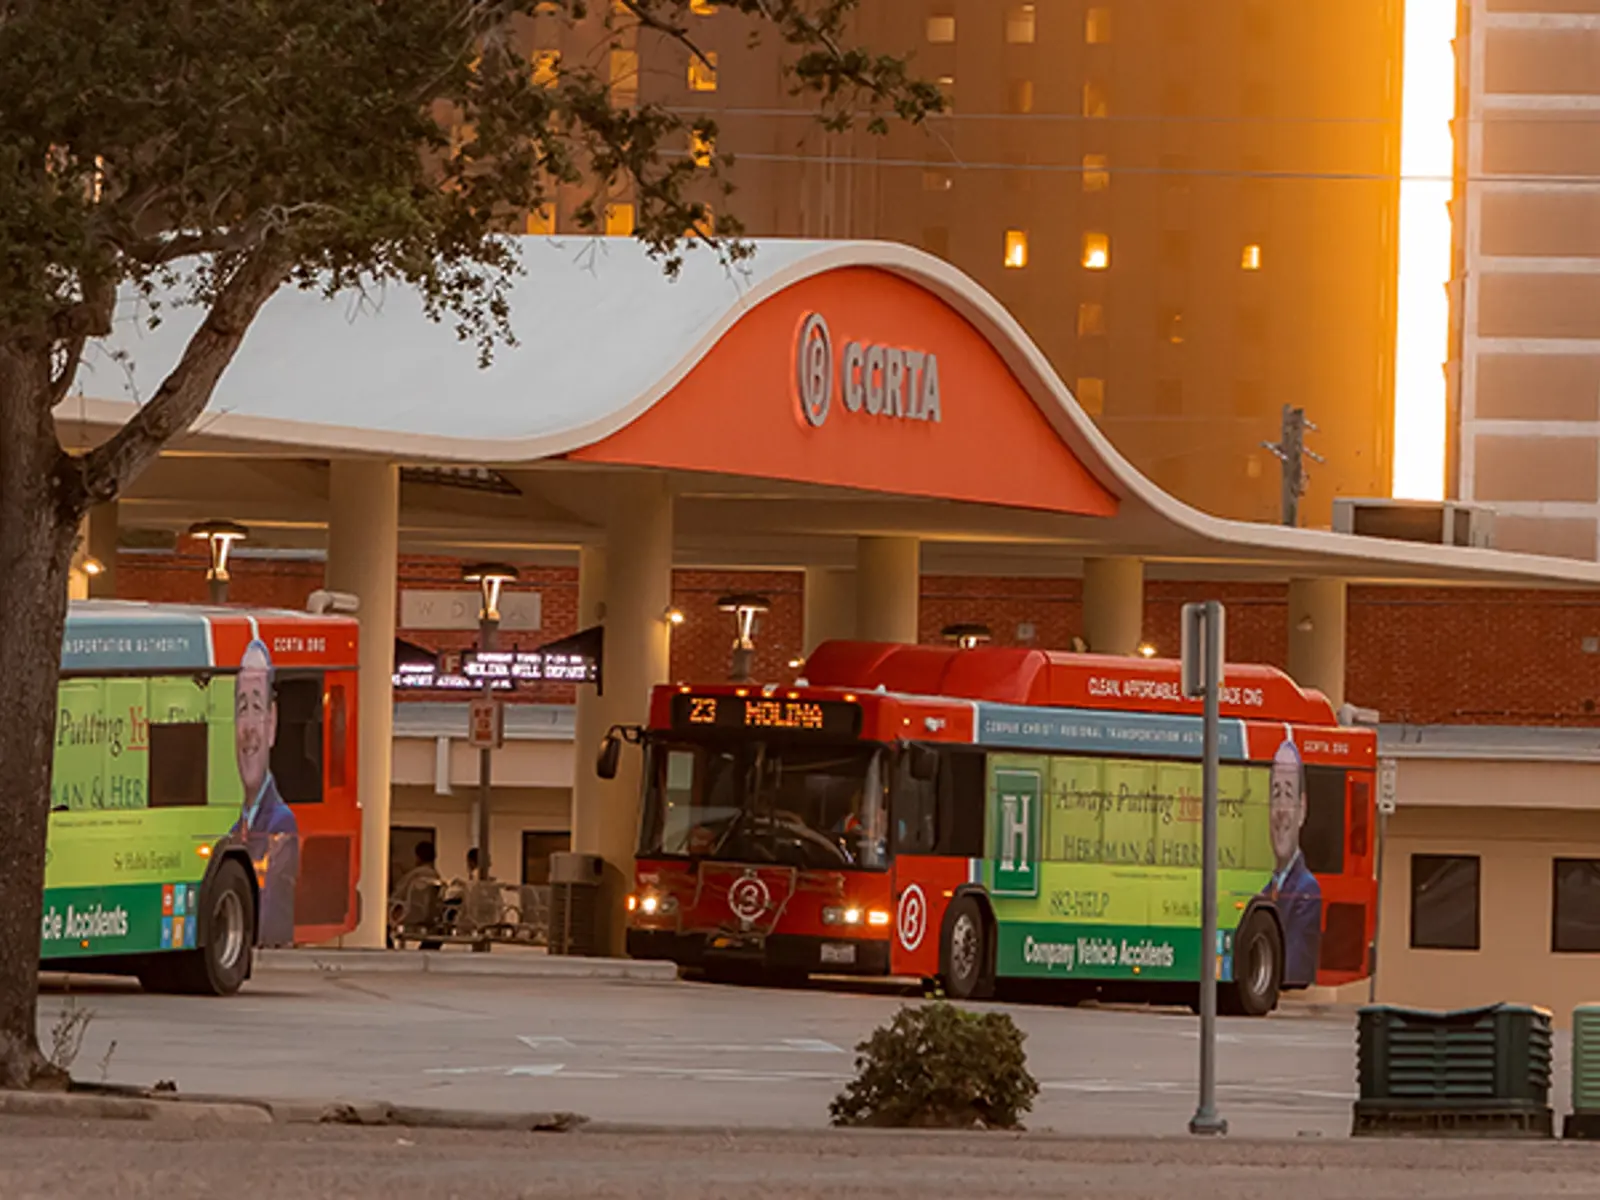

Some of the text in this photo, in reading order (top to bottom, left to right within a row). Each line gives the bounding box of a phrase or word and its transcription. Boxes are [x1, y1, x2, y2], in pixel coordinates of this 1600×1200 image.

[843, 341, 942, 423] CCRTA
[690, 698, 823, 728] 23 MOLINA
[58, 708, 124, 758] Putting
[1117, 782, 1175, 825] Putting
[1063, 834, 1140, 866] HERRMAN
[1144, 838, 1156, 865] &
[64, 903, 129, 939] Accidents
[1024, 935, 1175, 971] Company Vehicle Accidents
